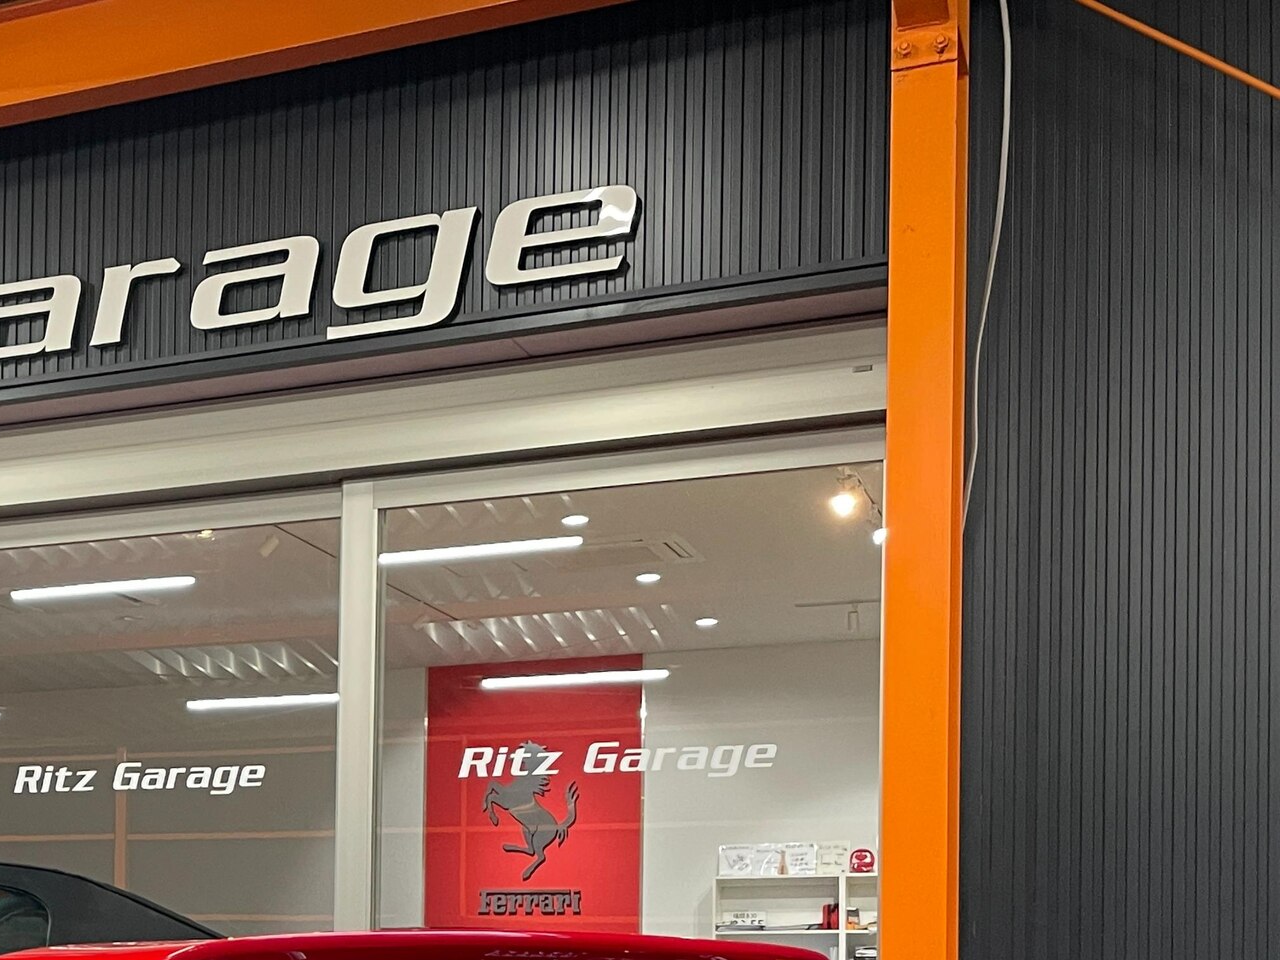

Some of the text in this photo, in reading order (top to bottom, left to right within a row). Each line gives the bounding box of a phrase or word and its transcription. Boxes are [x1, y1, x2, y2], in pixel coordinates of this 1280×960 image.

[458, 741, 778, 779] Ritz Garage
[14, 762, 266, 795] Ritz Garage
[478, 889, 581, 915] Ferrari
